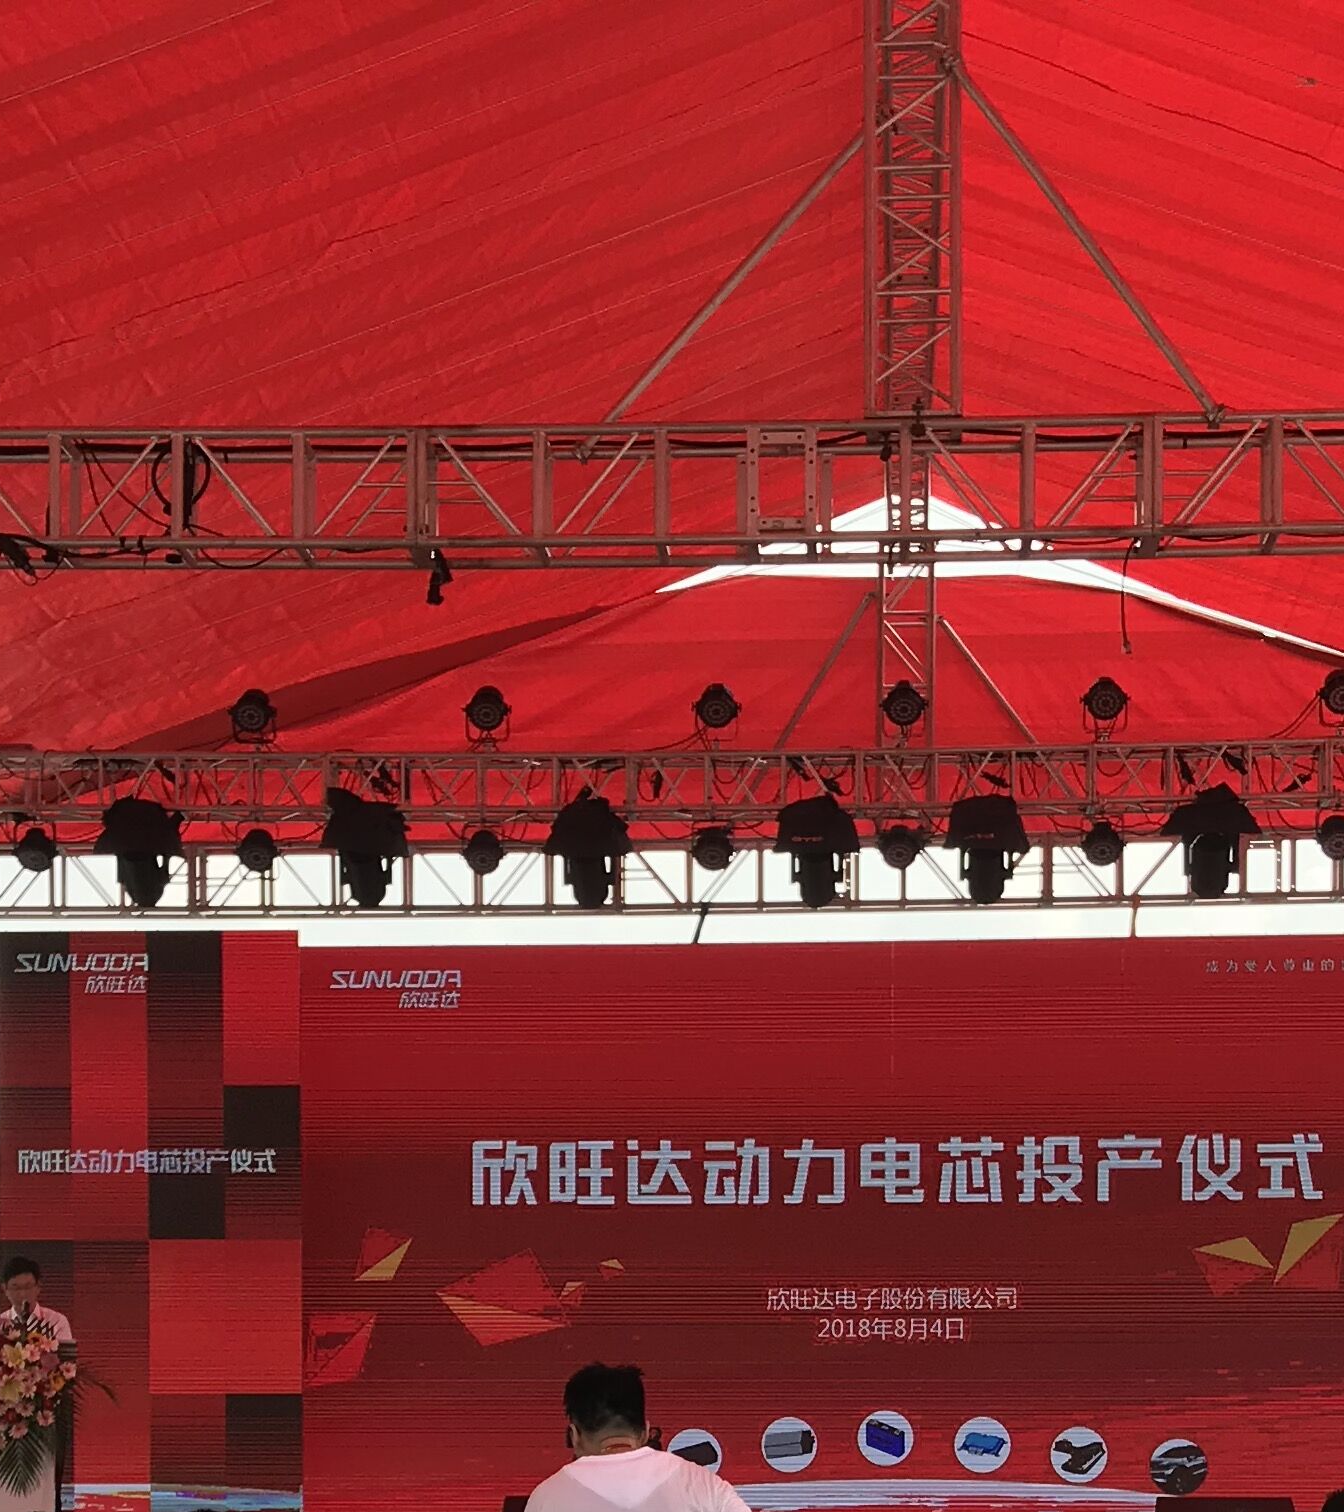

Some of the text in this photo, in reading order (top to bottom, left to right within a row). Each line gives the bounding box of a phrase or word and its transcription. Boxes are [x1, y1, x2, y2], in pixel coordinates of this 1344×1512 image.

[14, 953, 149, 972] SUNWODA
[84, 974, 148, 994] 欣旺达
[329, 970, 462, 989] SUNWODA
[398, 990, 461, 1009] 欣旺达
[17, 1149, 277, 1174] 欣旺达动力电芯投产仪式
[471, 1133, 1325, 1207] 欣旺达动力电芯投产仪式
[766, 1287, 1018, 1311] 欣旺达电子股份有限公司
[817, 1317, 965, 1341] 2018年8月4日
